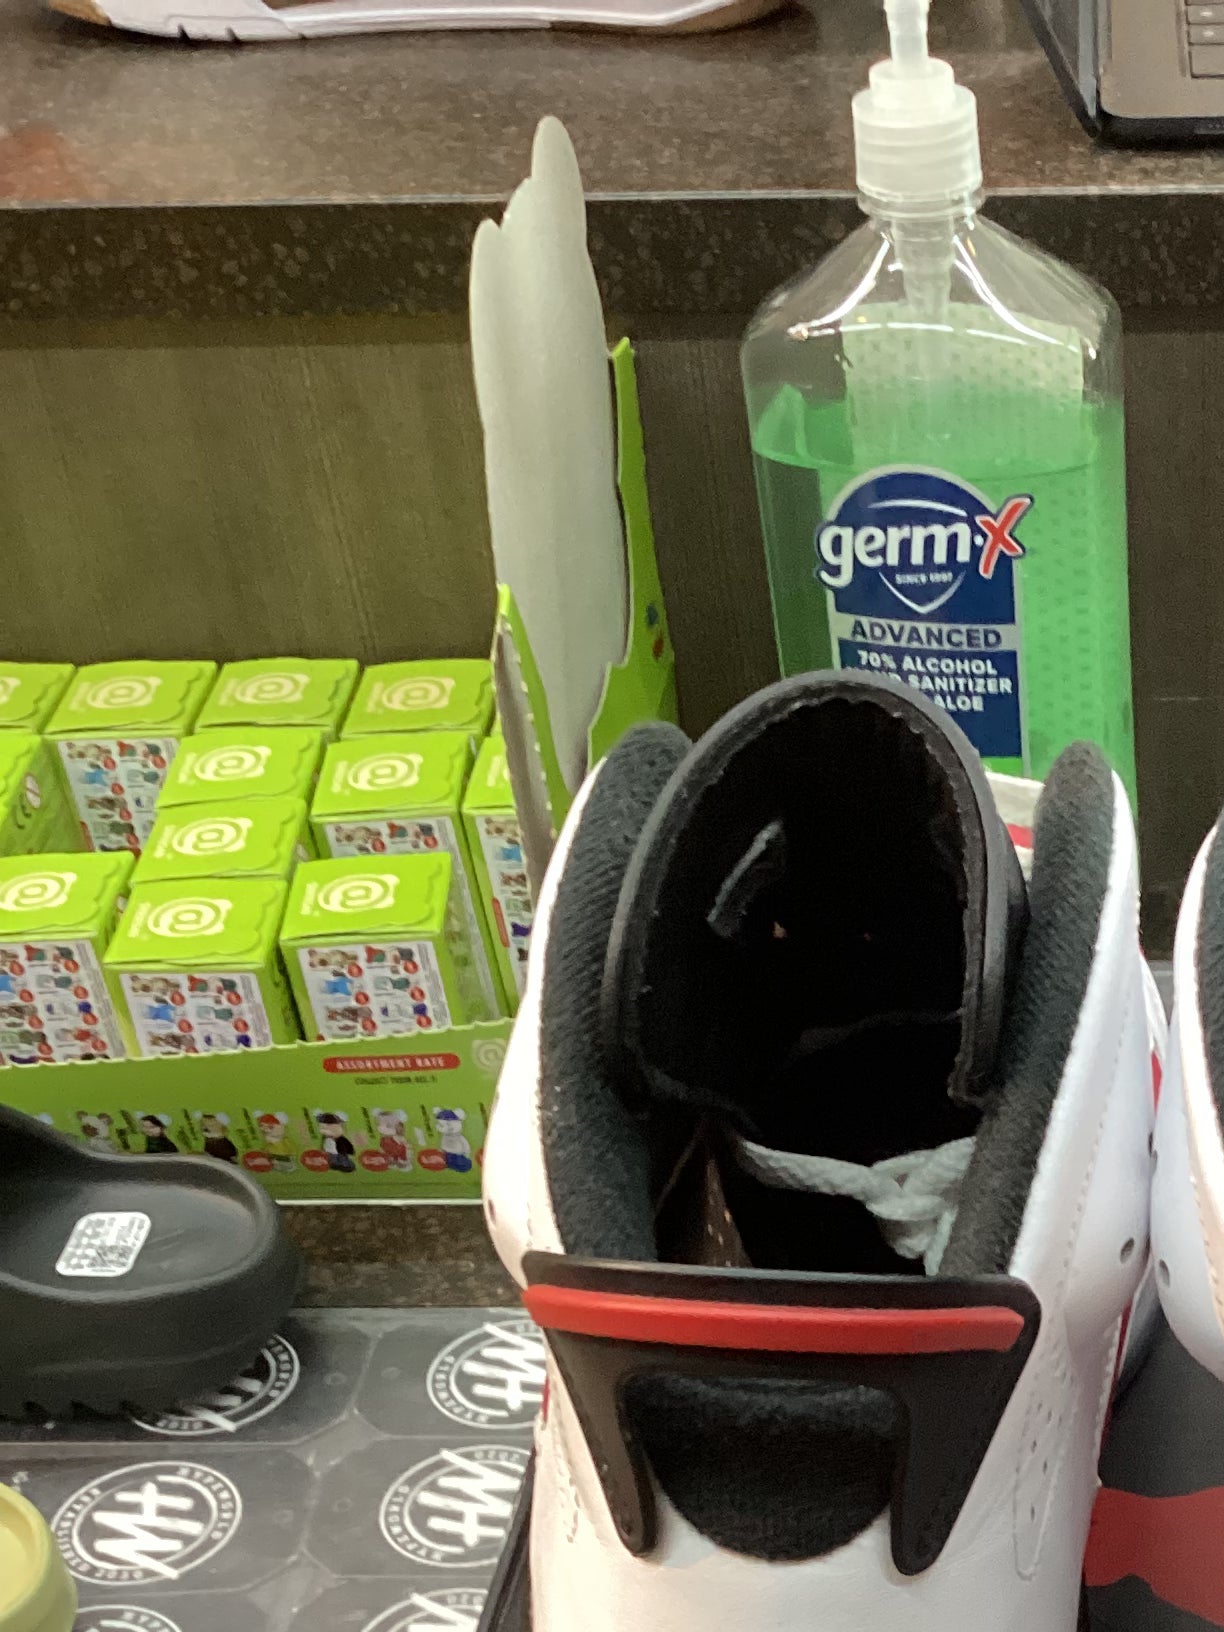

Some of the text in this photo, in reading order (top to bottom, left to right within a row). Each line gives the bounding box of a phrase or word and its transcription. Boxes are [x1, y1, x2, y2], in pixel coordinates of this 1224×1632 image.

[895, 573, 927, 585] SINCE
[851, 620, 1003, 648] ADVANCED
[857, 650, 897, 670] 70%
[902, 655, 998, 676] ALCOHOL
[908, 674, 1012, 695] SANITIZER
[933, 693, 985, 712] ALOE
